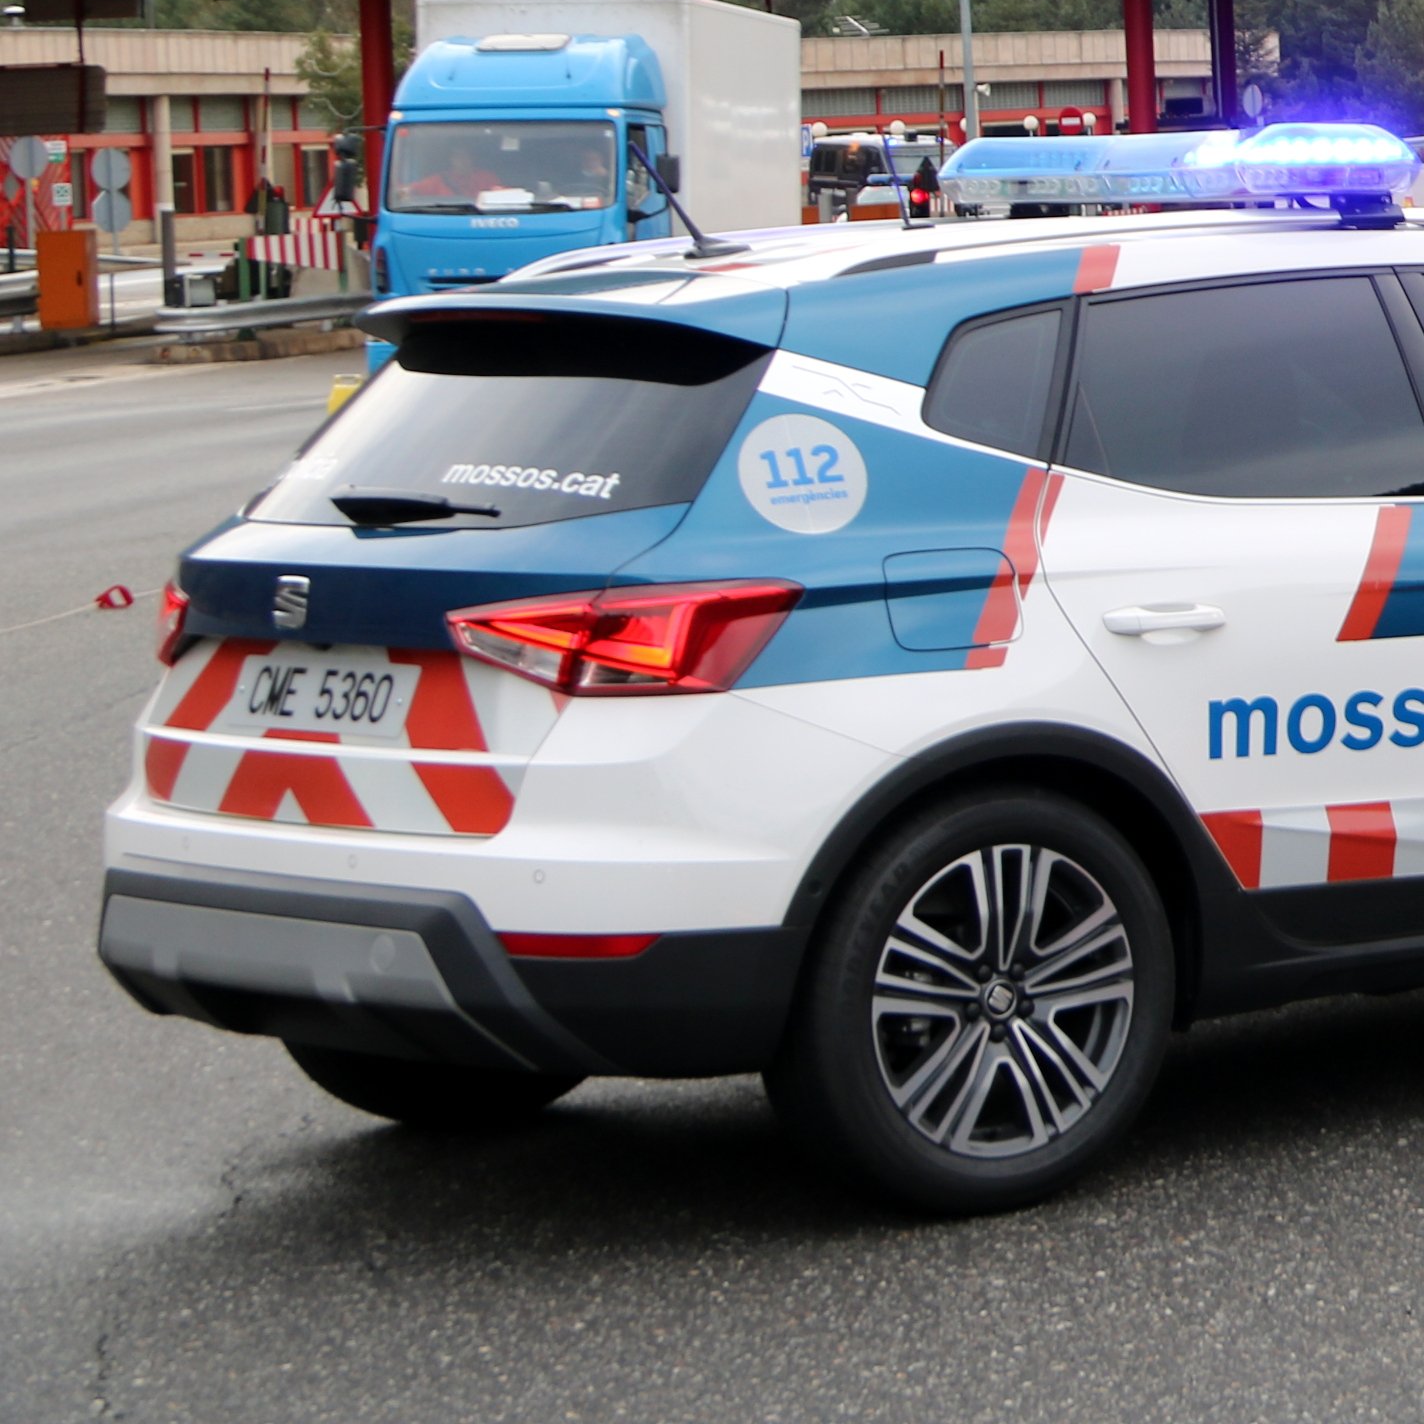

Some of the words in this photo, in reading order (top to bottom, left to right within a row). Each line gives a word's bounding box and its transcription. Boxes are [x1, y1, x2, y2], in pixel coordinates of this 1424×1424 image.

[470, 217, 520, 229] IVECO
[442, 462, 621, 500] mossos.cat
[759, 443, 845, 488] 112
[248, 665, 308, 717] CME
[315, 668, 395, 723] 5360
